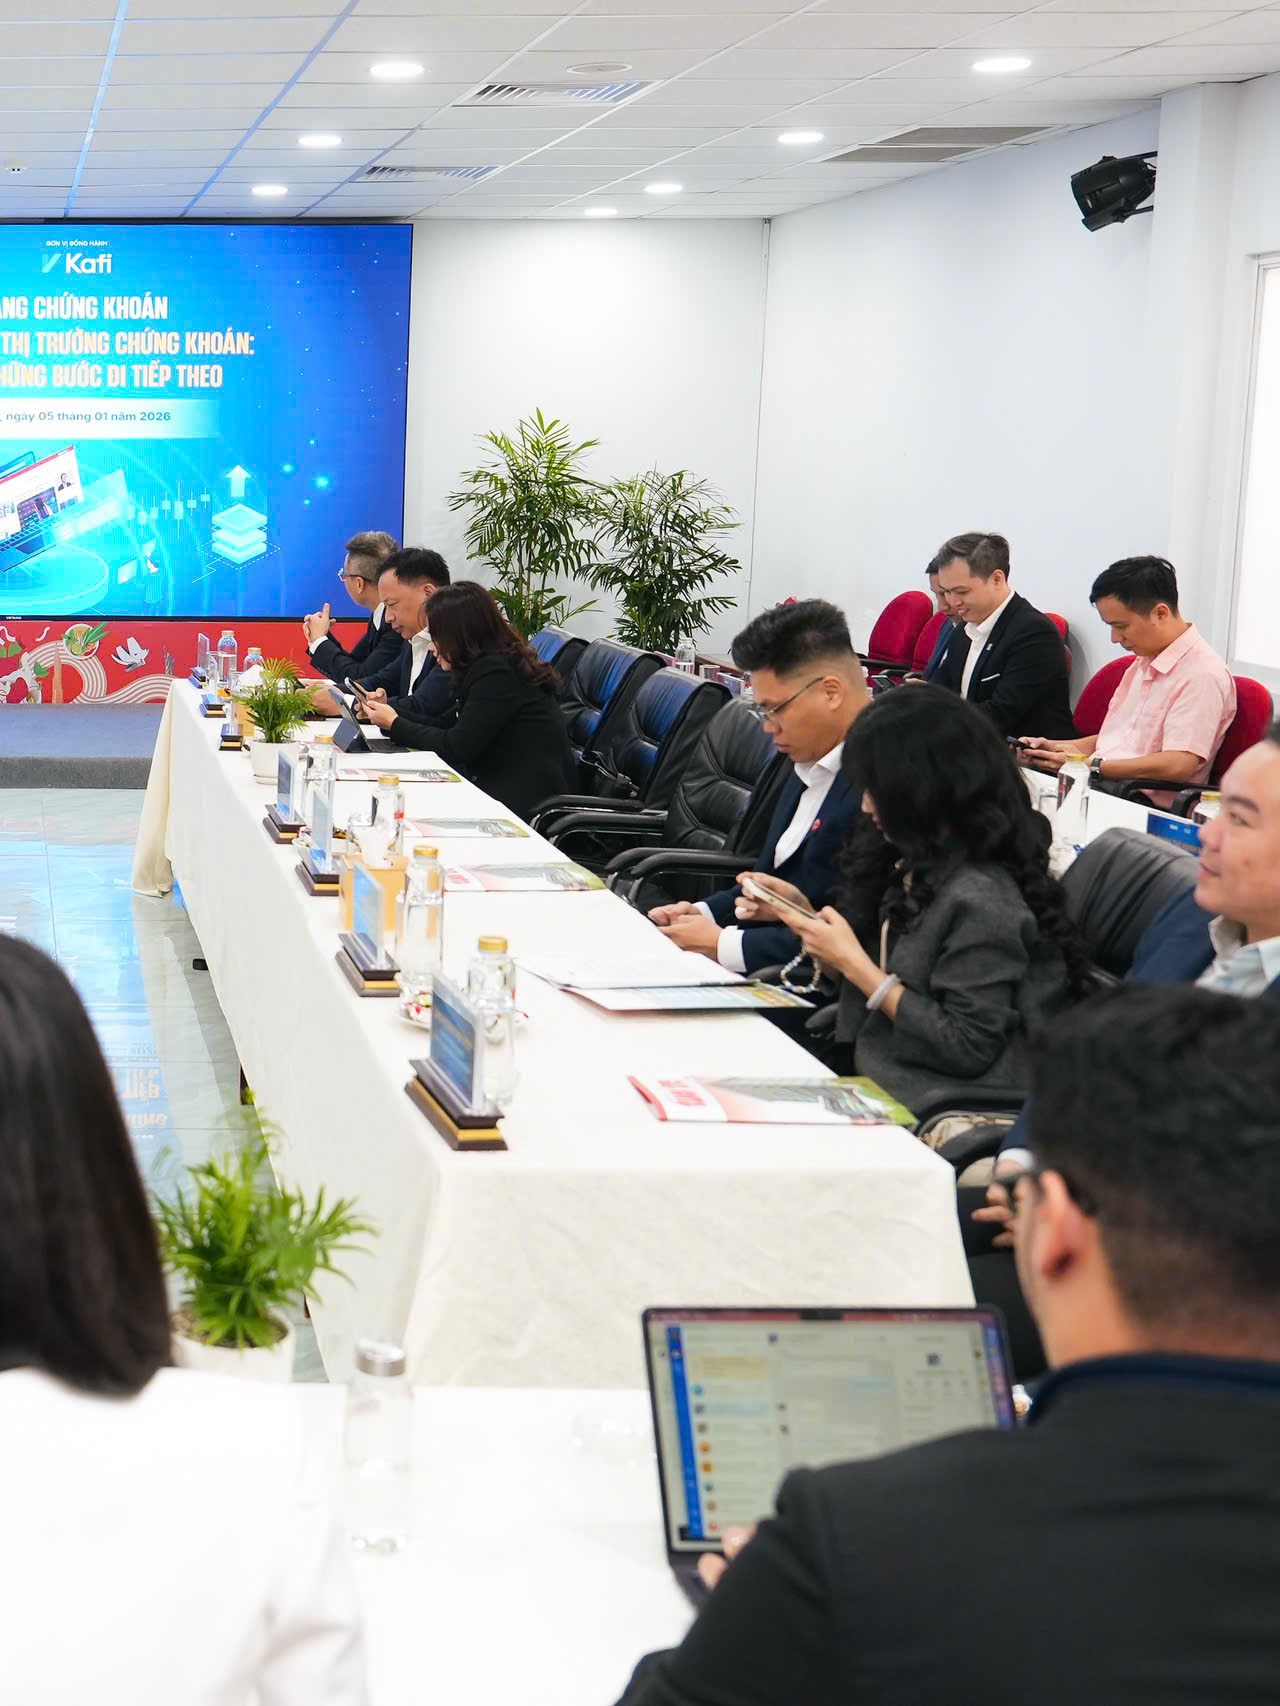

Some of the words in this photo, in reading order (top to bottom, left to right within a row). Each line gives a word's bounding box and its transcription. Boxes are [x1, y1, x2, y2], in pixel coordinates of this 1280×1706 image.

[66, 253, 112, 273] Kafi
[33, 291, 99, 320] CHỨNG
[103, 291, 169, 320] KHOÁN
[0, 331, 30, 358] THỊ
[35, 326, 110, 355] TRƯỜNG
[115, 327, 180, 355] CHỨNG
[185, 327, 255, 355] KHOÁN:
[52, 360, 103, 388] BƯỚC
[107, 364, 127, 388] ĐI
[131, 359, 172, 388] TIẾP
[176, 364, 223, 388] THEO
[6, 411, 35, 423] ngày
[38, 411, 54, 421] 05
[57, 411, 91, 423] tháng
[94, 411, 108, 421] 01
[111, 411, 136, 421] năm
[140, 411, 171, 421] 2026
